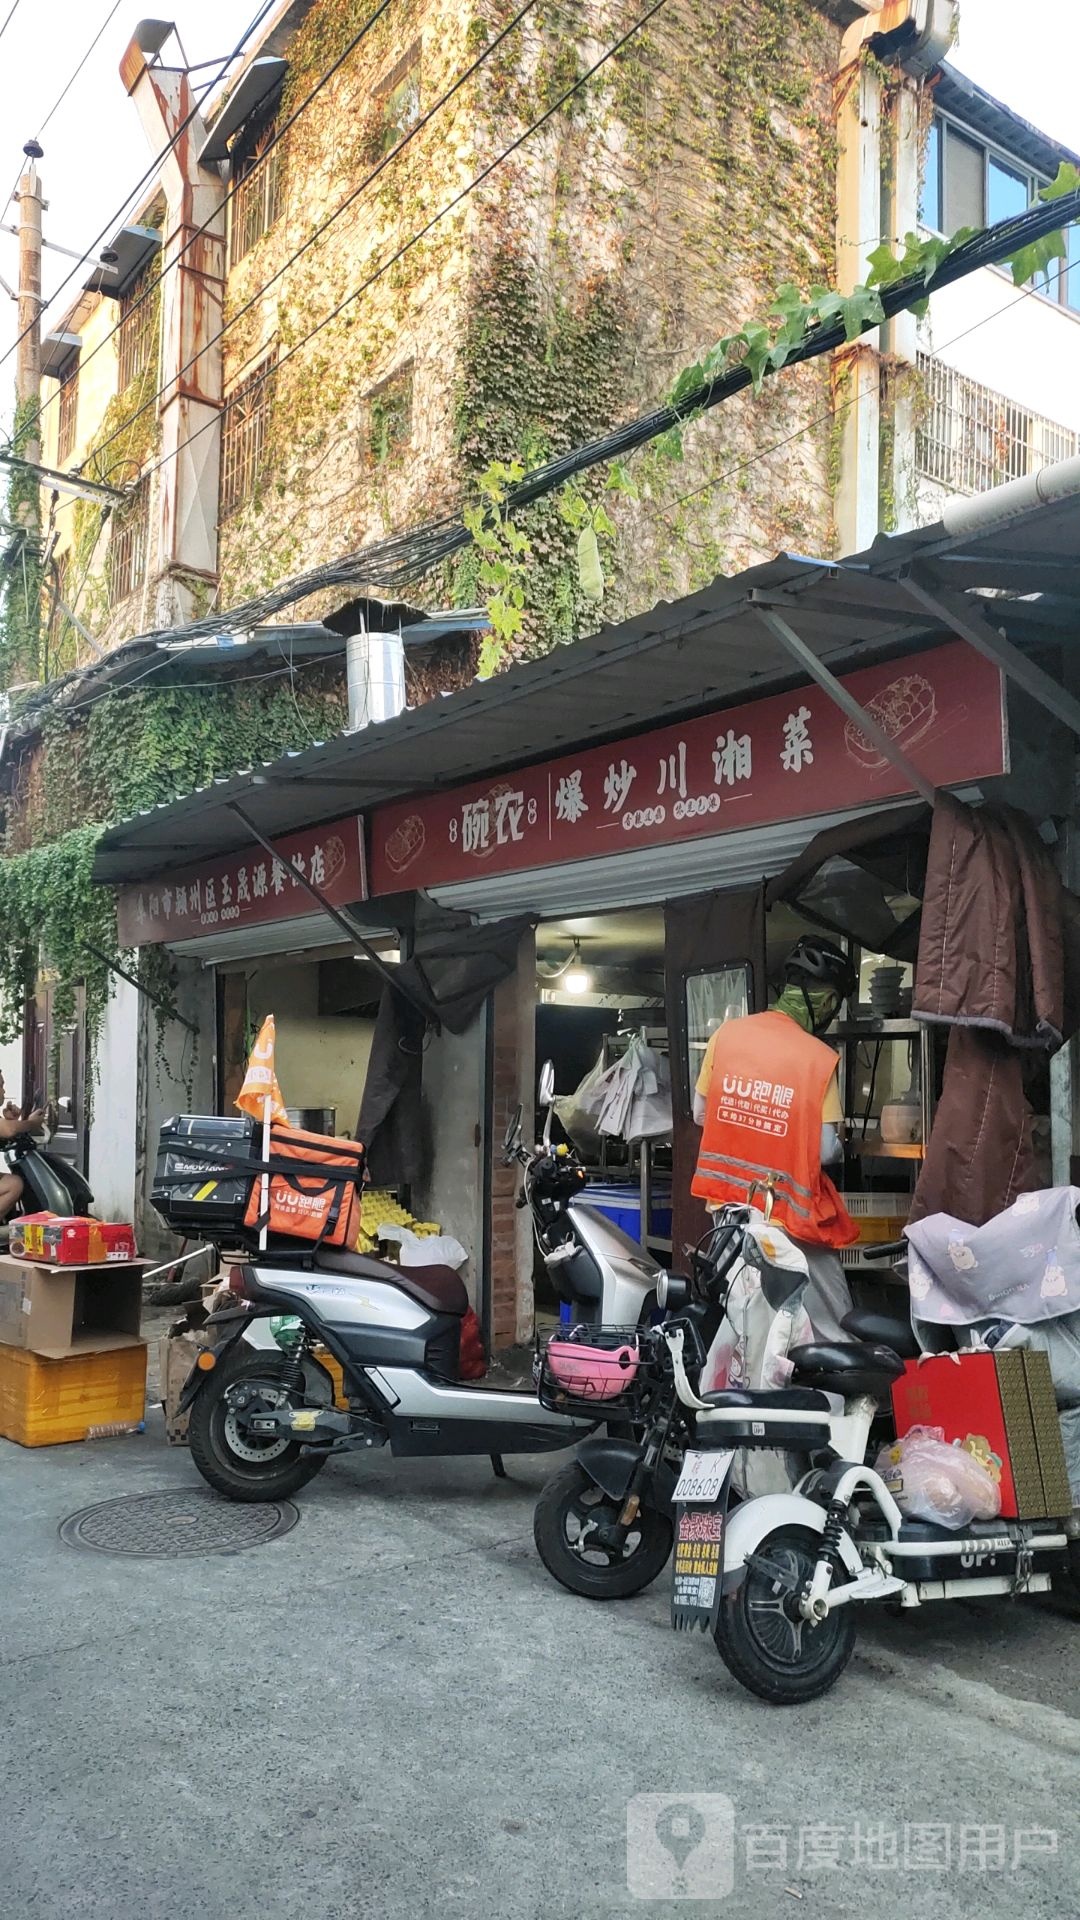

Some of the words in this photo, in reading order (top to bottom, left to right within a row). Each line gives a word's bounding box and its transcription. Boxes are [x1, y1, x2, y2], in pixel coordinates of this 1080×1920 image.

[461, 791, 524, 853] 碗农
[554, 706, 814, 823] 爆炒川湘菜
[676, 1478, 719, 1497] 008608
